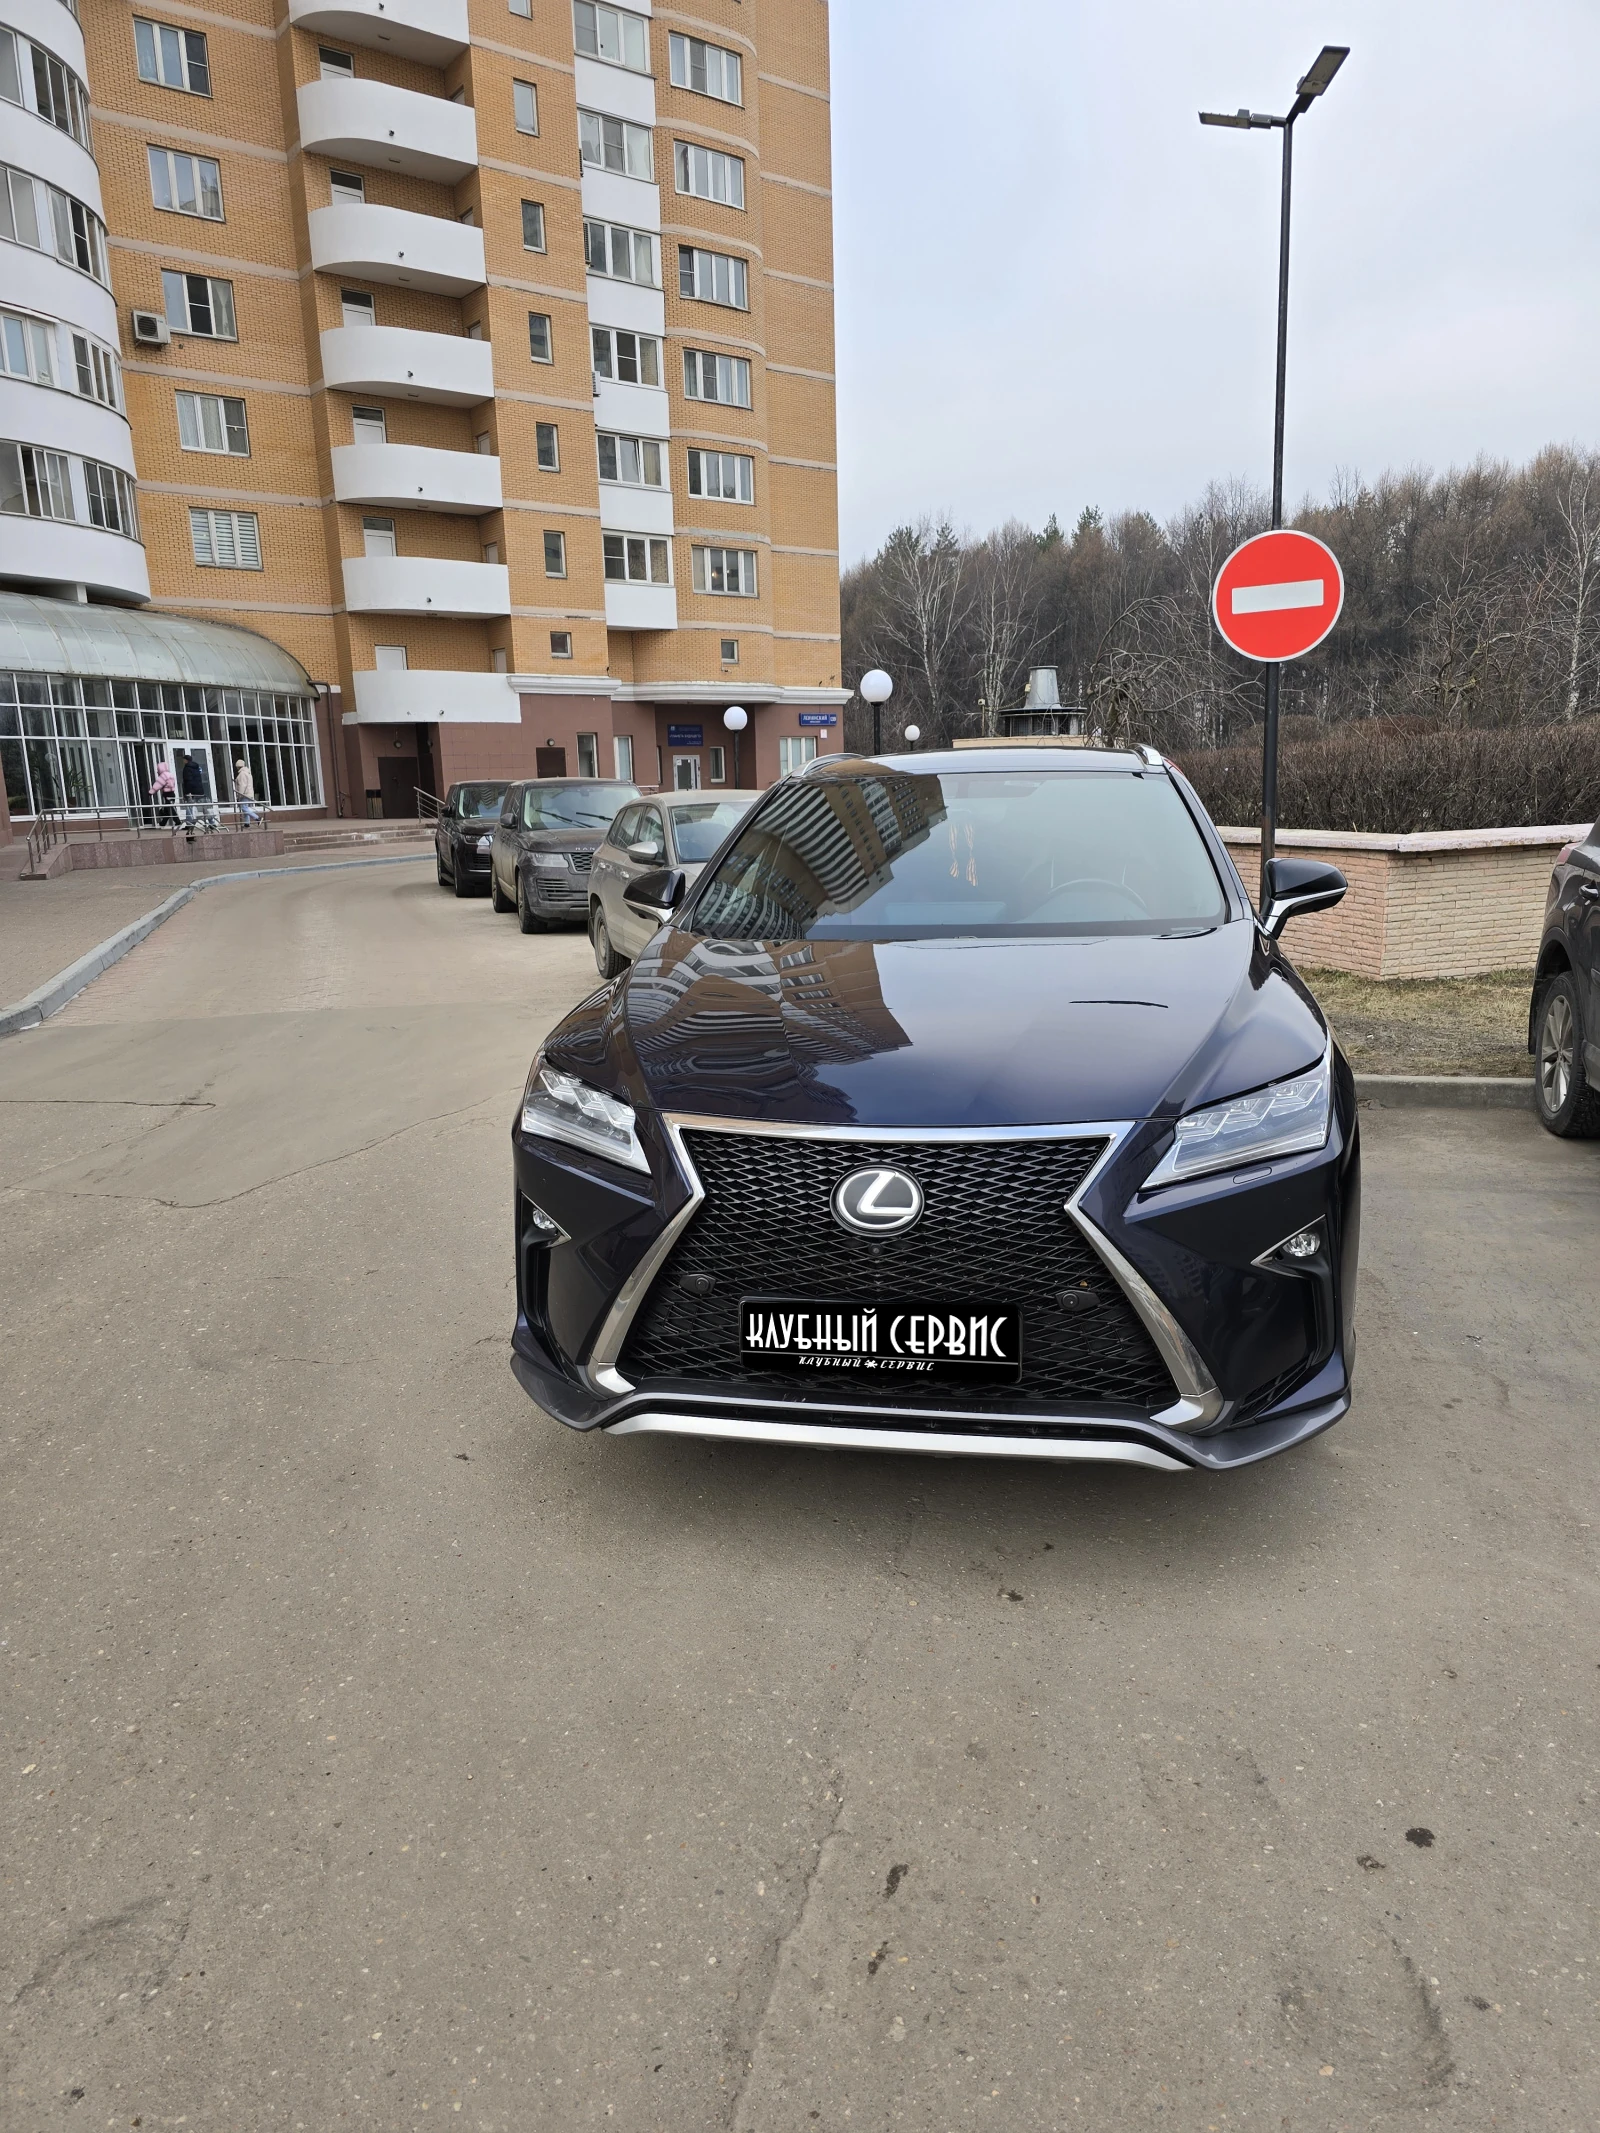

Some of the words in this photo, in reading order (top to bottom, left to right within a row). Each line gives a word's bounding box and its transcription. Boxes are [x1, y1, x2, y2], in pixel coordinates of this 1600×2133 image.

[745, 1308, 877, 1352] КЛУБНЫЙ
[889, 1314, 1008, 1357] СЕРВИС
[798, 1356, 861, 1368] КЛУБНЫЙ
[879, 1360, 935, 1371] СЕРВИС
